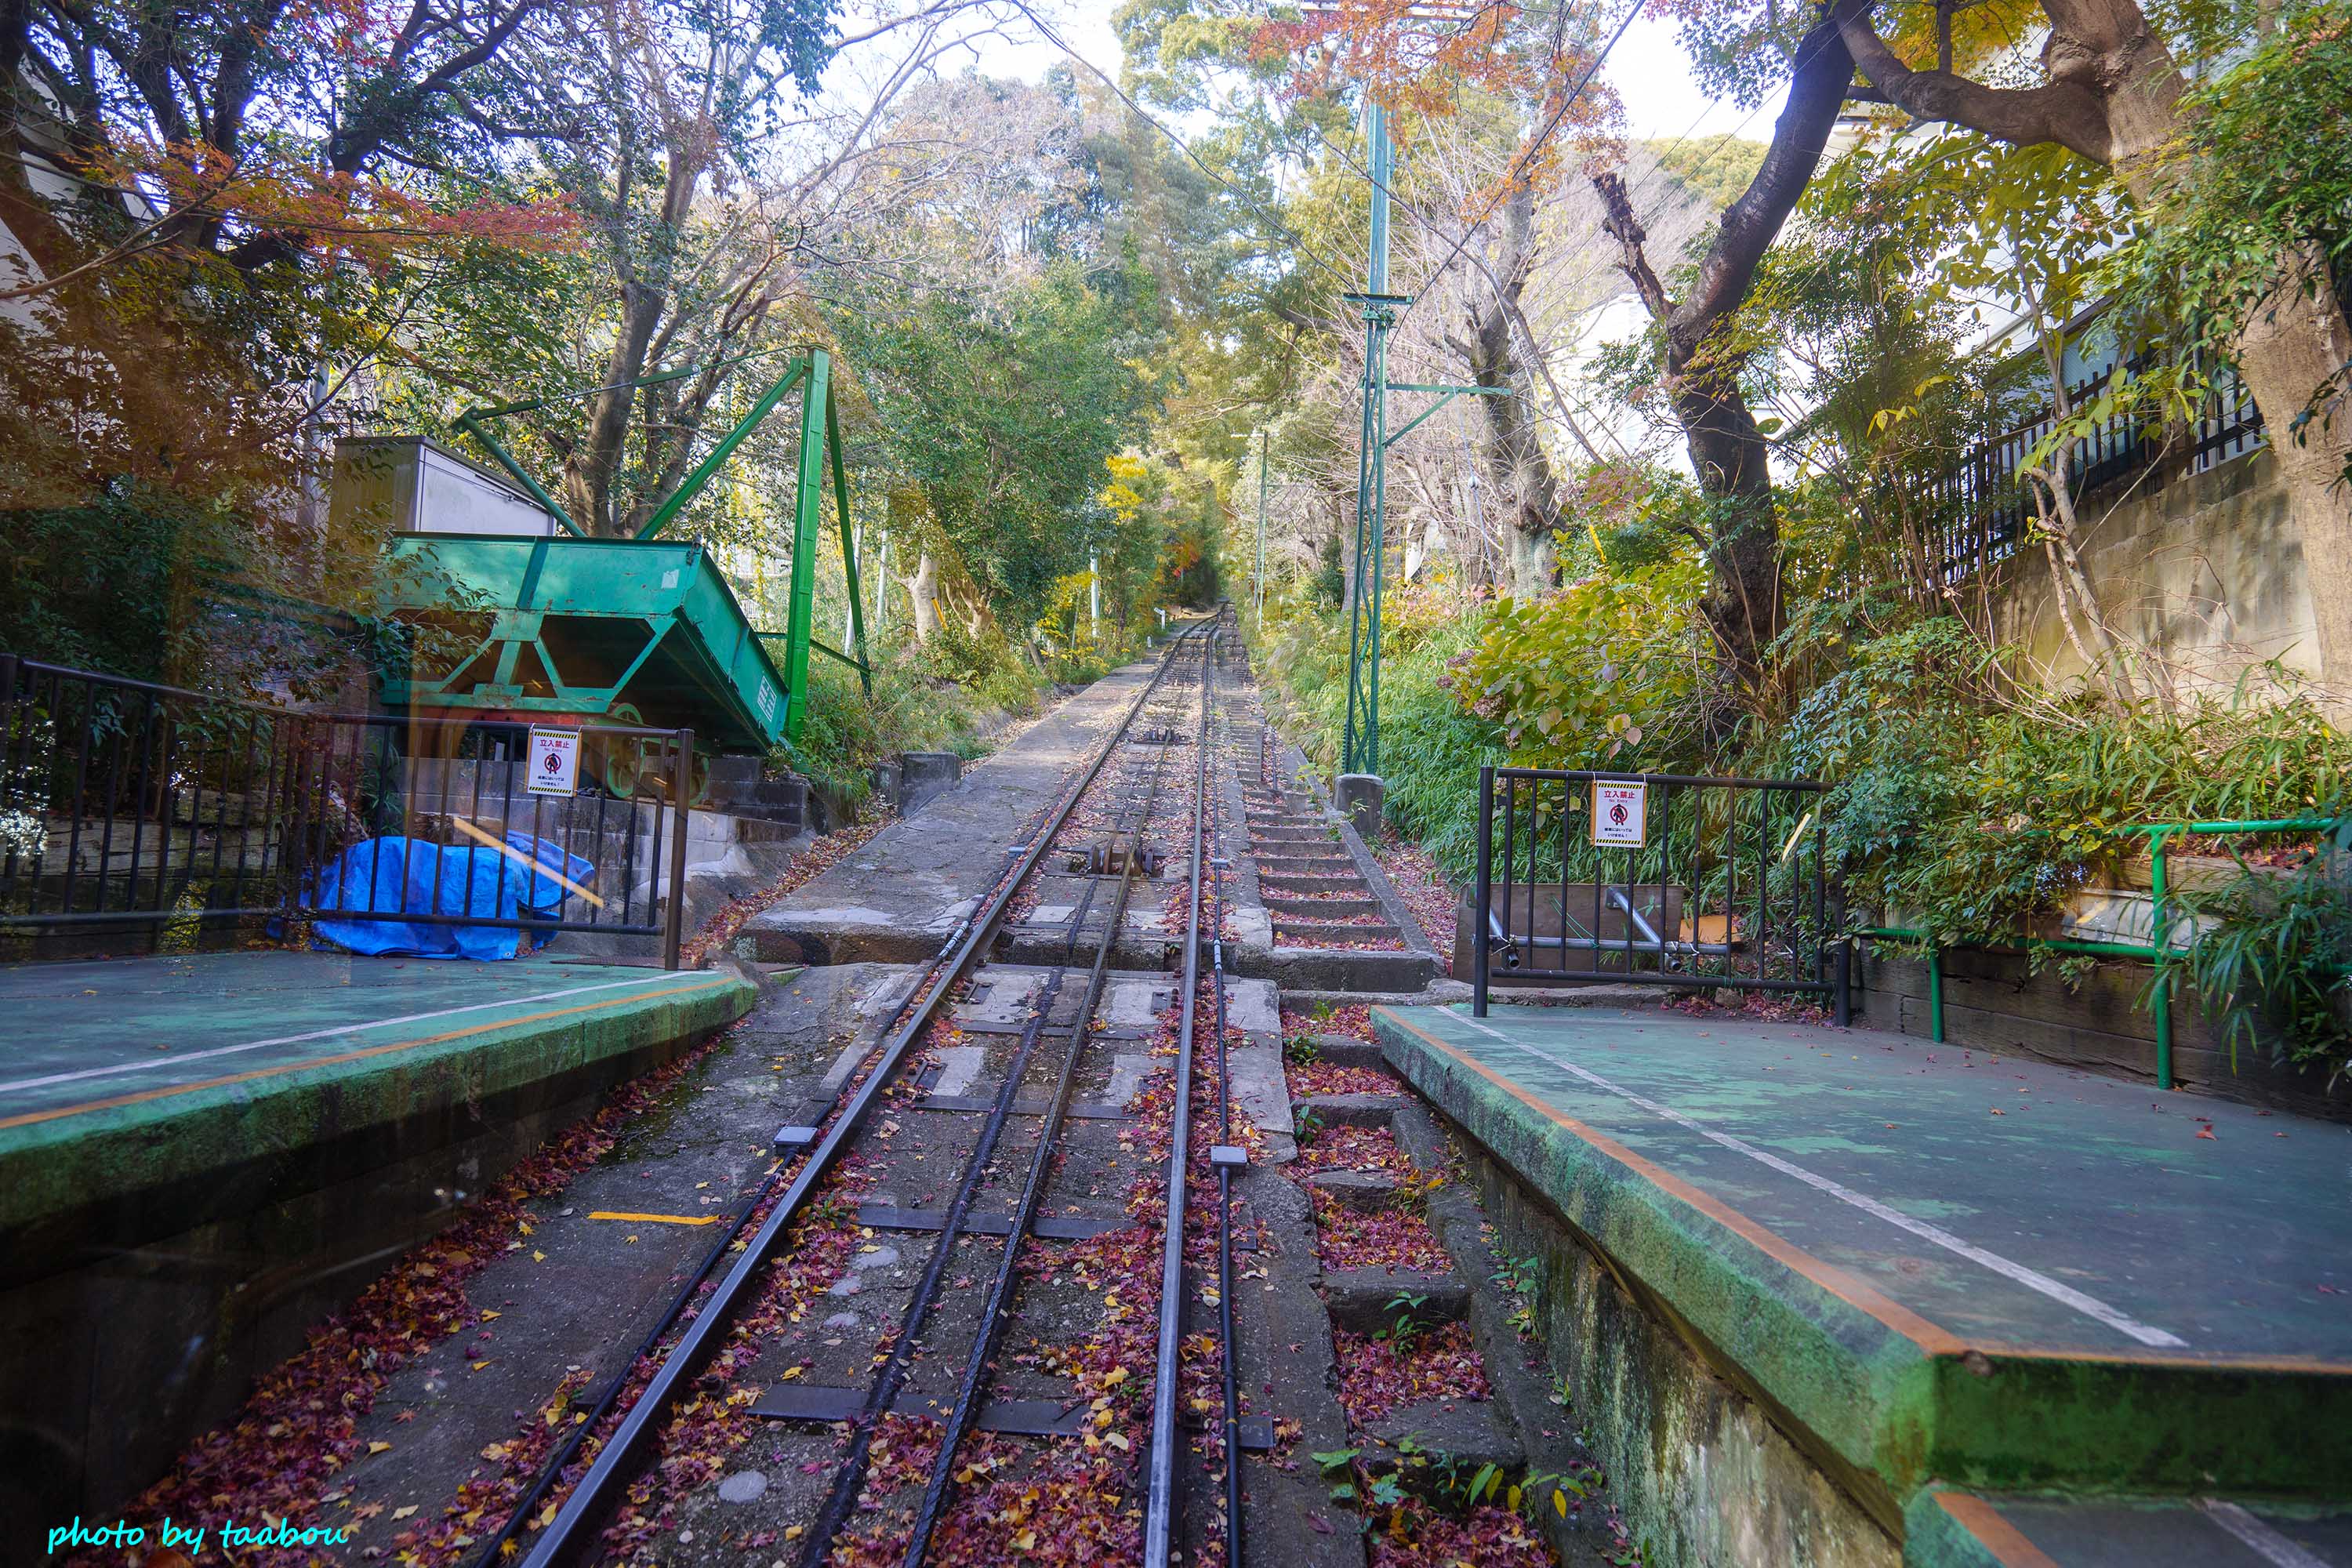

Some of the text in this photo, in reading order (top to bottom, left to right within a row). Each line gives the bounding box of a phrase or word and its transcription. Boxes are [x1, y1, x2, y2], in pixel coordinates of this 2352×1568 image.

[539, 739, 570, 749] 立入禁止
[1604, 790, 1635, 799] 立入禁止
